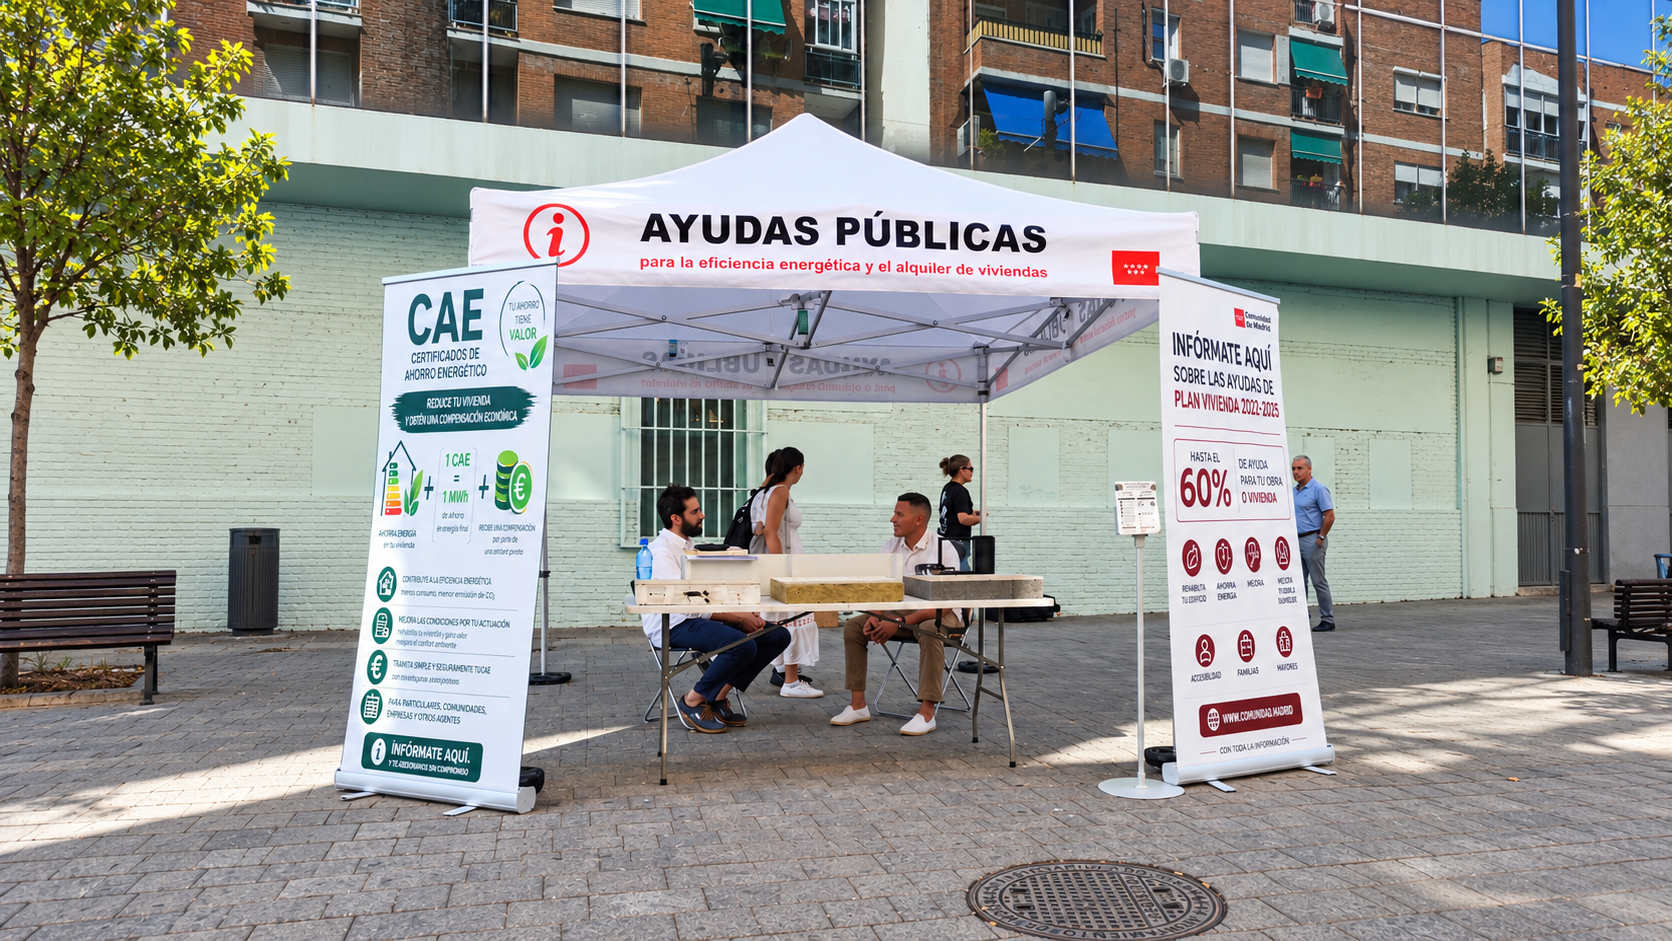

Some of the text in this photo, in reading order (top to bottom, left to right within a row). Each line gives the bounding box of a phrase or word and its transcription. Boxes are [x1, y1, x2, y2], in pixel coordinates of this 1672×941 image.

[640, 210, 1047, 253] AYUDAS PÚBLICAS
[640, 256, 1048, 278] para la eficiencia energética y el alquiler de viviendas
[508, 302, 516, 312] TU
[407, 288, 484, 346] CAE
[1245, 311, 1271, 324] Comunidad
[509, 327, 537, 341] VALOR
[411, 347, 480, 364] CERTIFICADOS DE
[1172, 330, 1272, 373] INFÓRMATE AQUÍ
[404, 363, 487, 381] AHORRO ENERGÉTICO
[1173, 365, 1274, 396] SOBRE LAS AYUDAS DE
[426, 394, 491, 409] REDUCE TU VIVIENDA
[1174, 389, 1280, 418] PLAN VIVIENDA 2022-2025
[405, 415, 409, 426] Y
[445, 452, 471, 467] 1 CAE
[1190, 451, 1220, 463] HASTA EL
[1238, 458, 1268, 470] DE AYUDA
[1180, 467, 1232, 508] 60%
[1240, 475, 1284, 487] PARA TU OBRA
[442, 489, 469, 503] 1 MWh
[1241, 491, 1278, 504] O VIVIENDA
[459, 618, 471, 627] POR
[444, 746, 471, 765] AQUÍ.
[1219, 746, 1232, 755] CON
